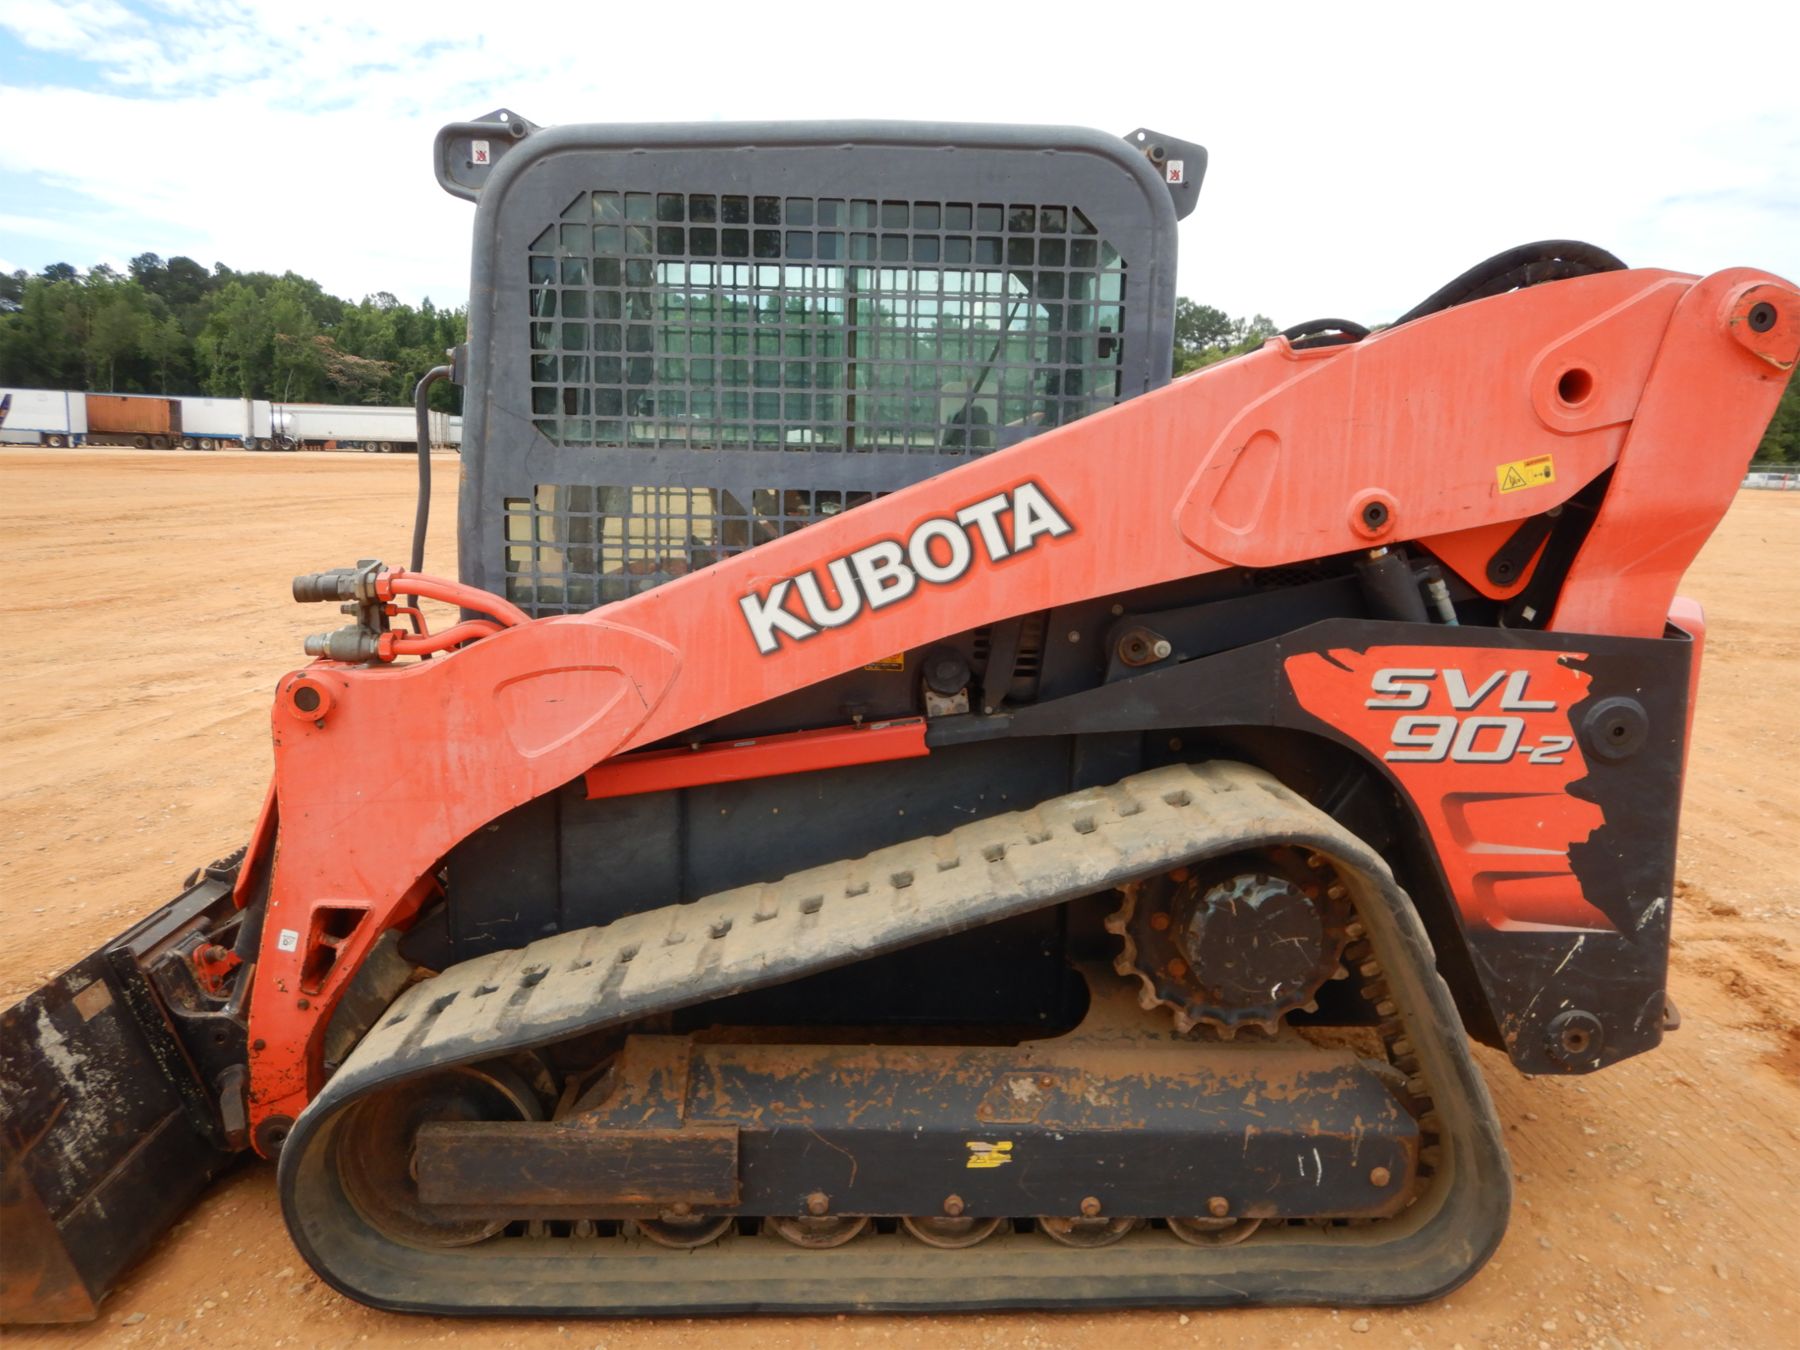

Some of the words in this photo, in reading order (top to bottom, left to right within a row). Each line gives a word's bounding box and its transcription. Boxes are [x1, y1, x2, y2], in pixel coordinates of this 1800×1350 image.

[739, 482, 1073, 654] KUBOTA
[1364, 668, 1558, 711] SVL
[1384, 715, 1574, 763] 90-2
